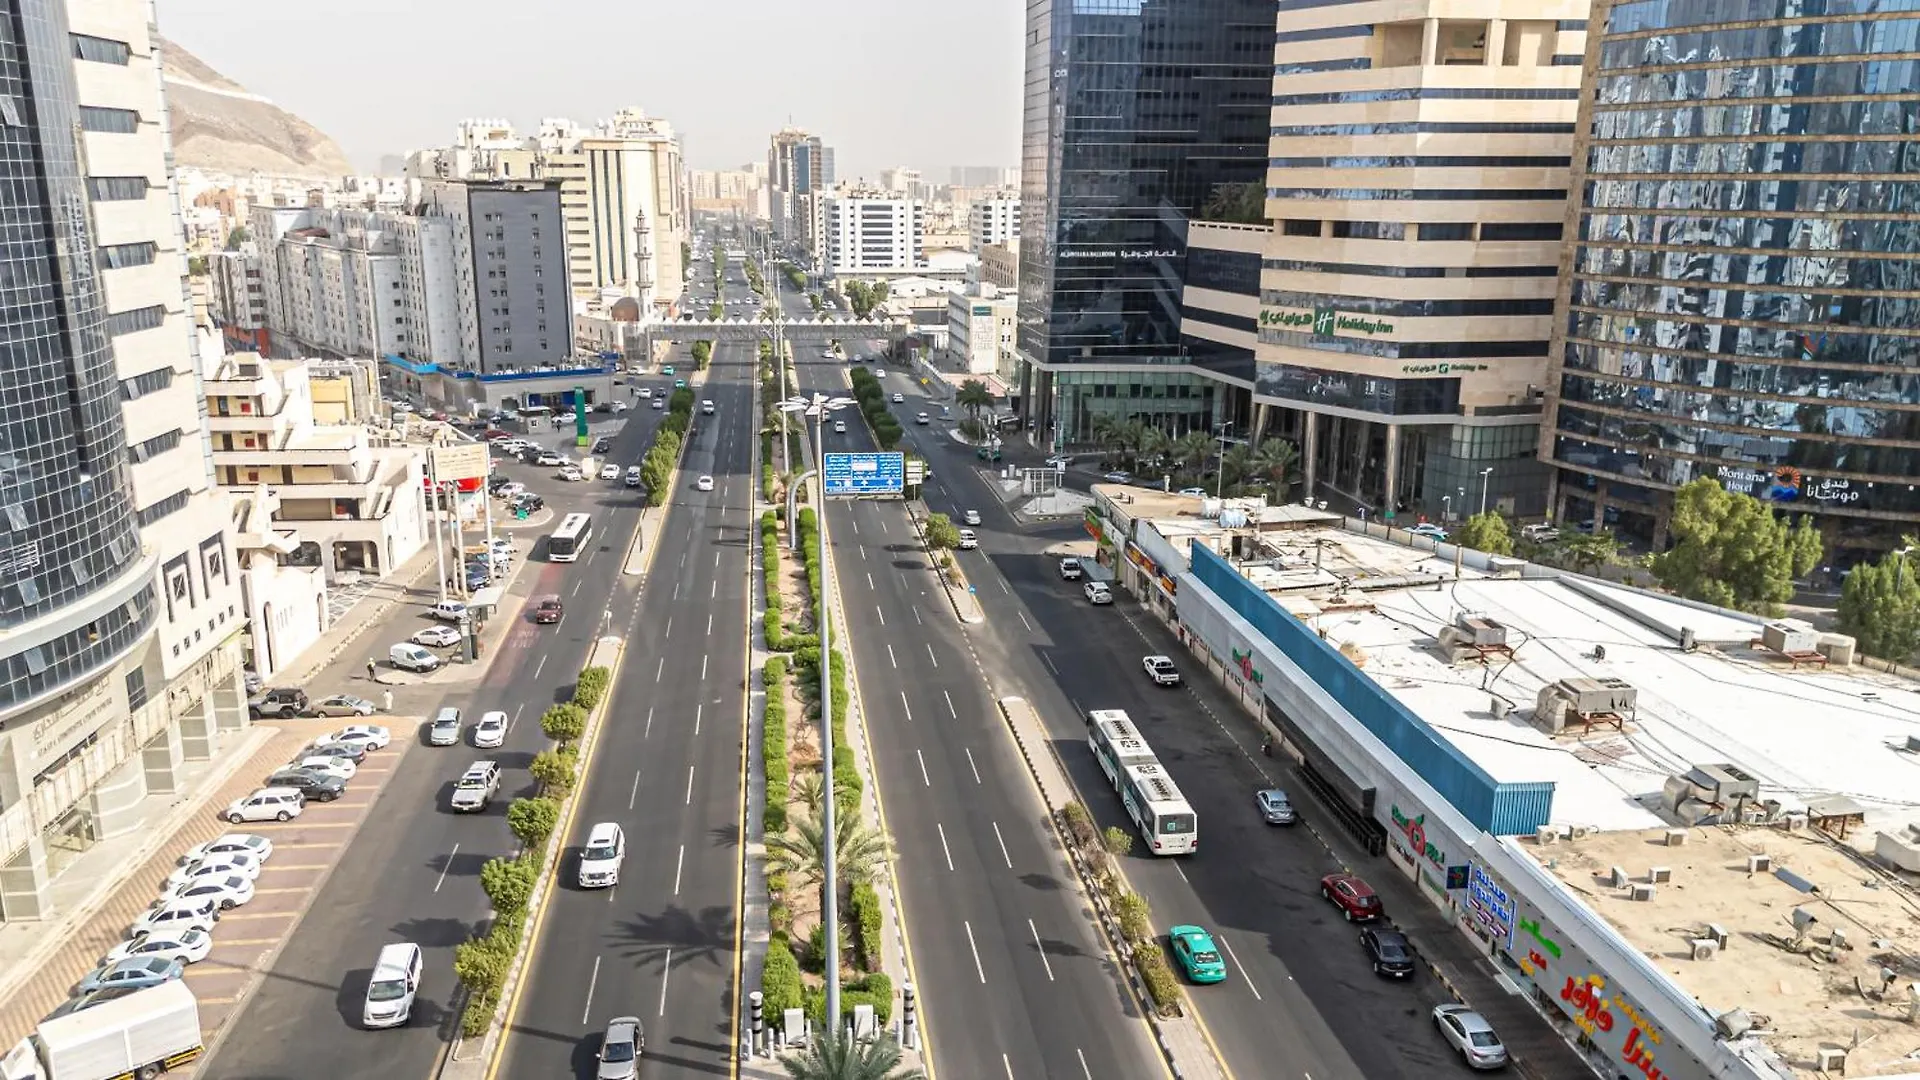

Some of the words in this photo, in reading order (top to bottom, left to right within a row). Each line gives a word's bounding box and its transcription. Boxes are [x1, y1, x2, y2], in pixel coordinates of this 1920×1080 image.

[1337, 316, 1377, 335] Holiday
[1375, 323, 1394, 334] Inn
[1717, 465, 1766, 483] Montana
[1726, 480, 1753, 492] Hotel
[1820, 478, 1850, 490] فندق
[1806, 484, 1860, 504] مونتانا
[1476, 865, 1508, 904] صيدلية
